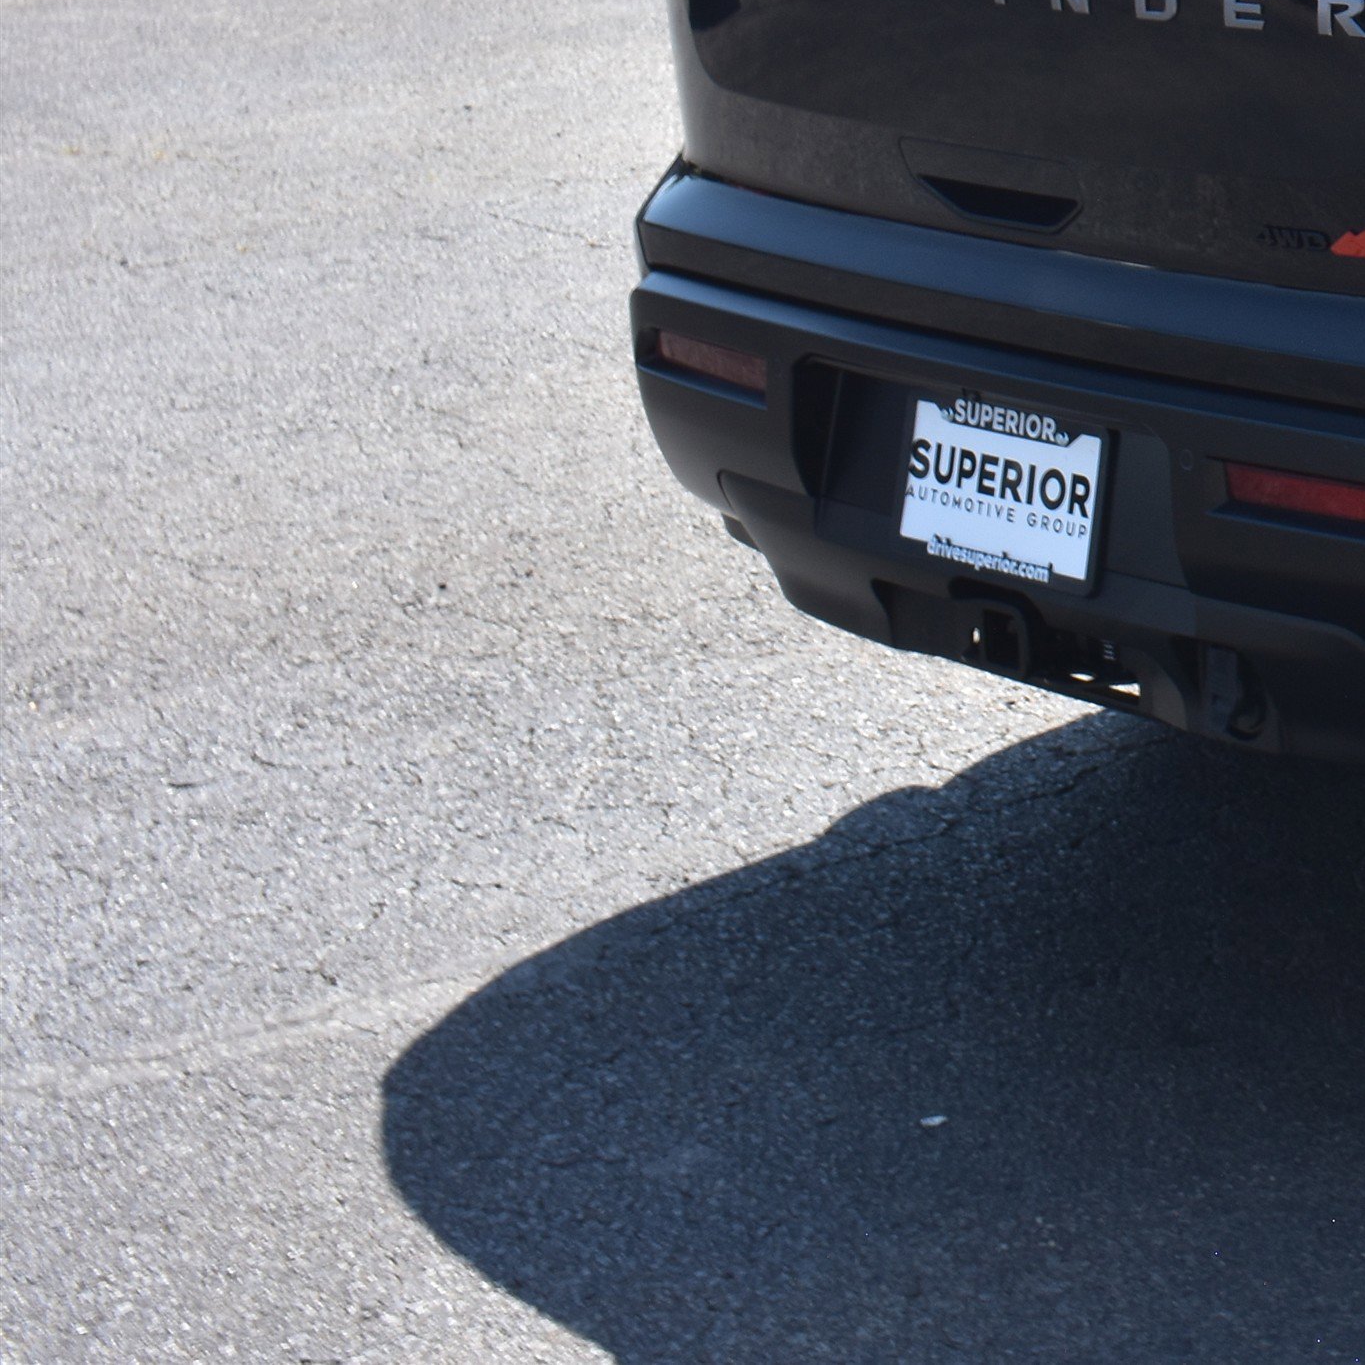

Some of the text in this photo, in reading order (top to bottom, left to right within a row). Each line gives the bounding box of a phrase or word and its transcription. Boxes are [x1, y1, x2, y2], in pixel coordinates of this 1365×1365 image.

[954, 398, 1058, 442] SUPERIOR
[908, 438, 1090, 519] SUPERIOR
[904, 484, 1088, 539] AUTOMOTIVE GROUP
[926, 536, 1051, 583] drivesuperior.com
